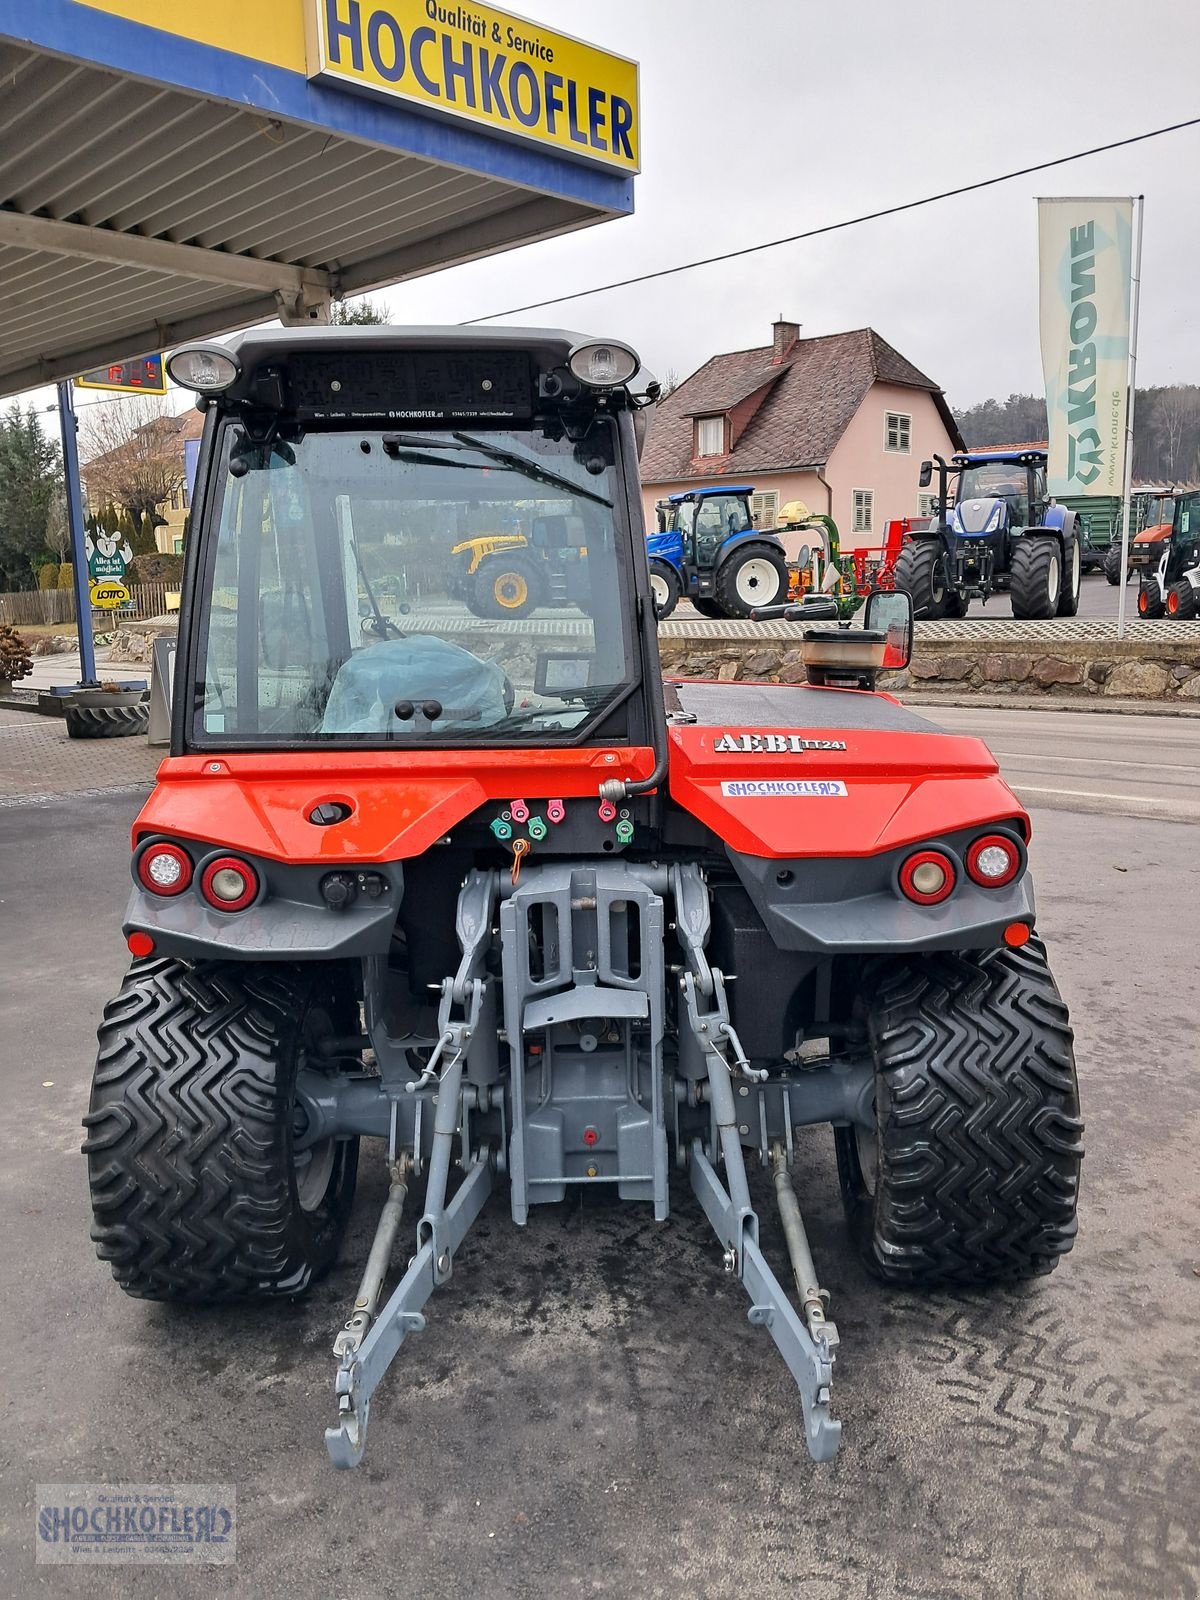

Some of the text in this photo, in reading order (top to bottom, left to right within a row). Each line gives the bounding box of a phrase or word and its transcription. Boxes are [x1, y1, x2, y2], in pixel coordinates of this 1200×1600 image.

[426, 0, 554, 63] Qualität & Service
[325, 0, 634, 160] HOCHKOFLER
[94, 557, 111, 565] Alles
[95, 565, 122, 575] möglich!
[97, 590, 125, 600] LOTTO
[714, 734, 847, 753] AEBI TT241
[735, 782, 829, 795] HOCHKOFLER
